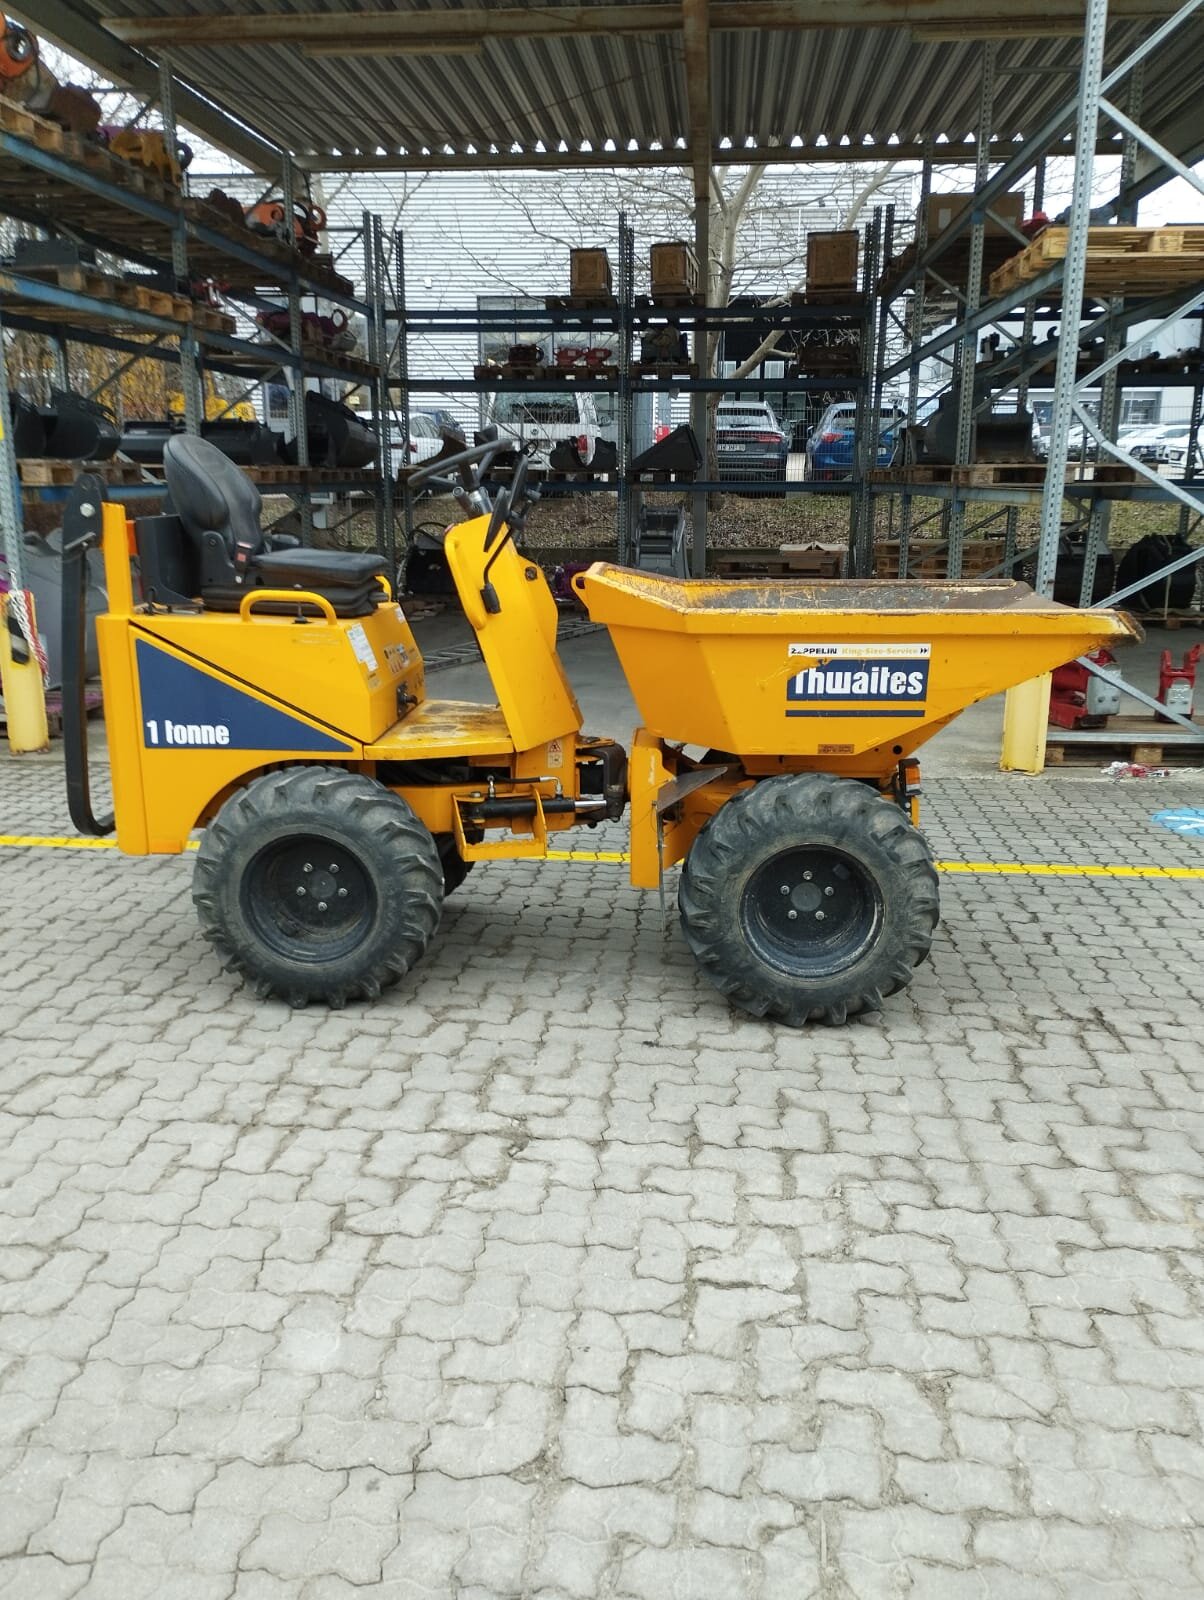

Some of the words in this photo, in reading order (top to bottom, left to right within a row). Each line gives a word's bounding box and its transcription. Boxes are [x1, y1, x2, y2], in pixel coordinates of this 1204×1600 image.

[795, 666, 924, 695] Thwaites
[146, 719, 159, 745] 1
[164, 719, 230, 745] tonne
